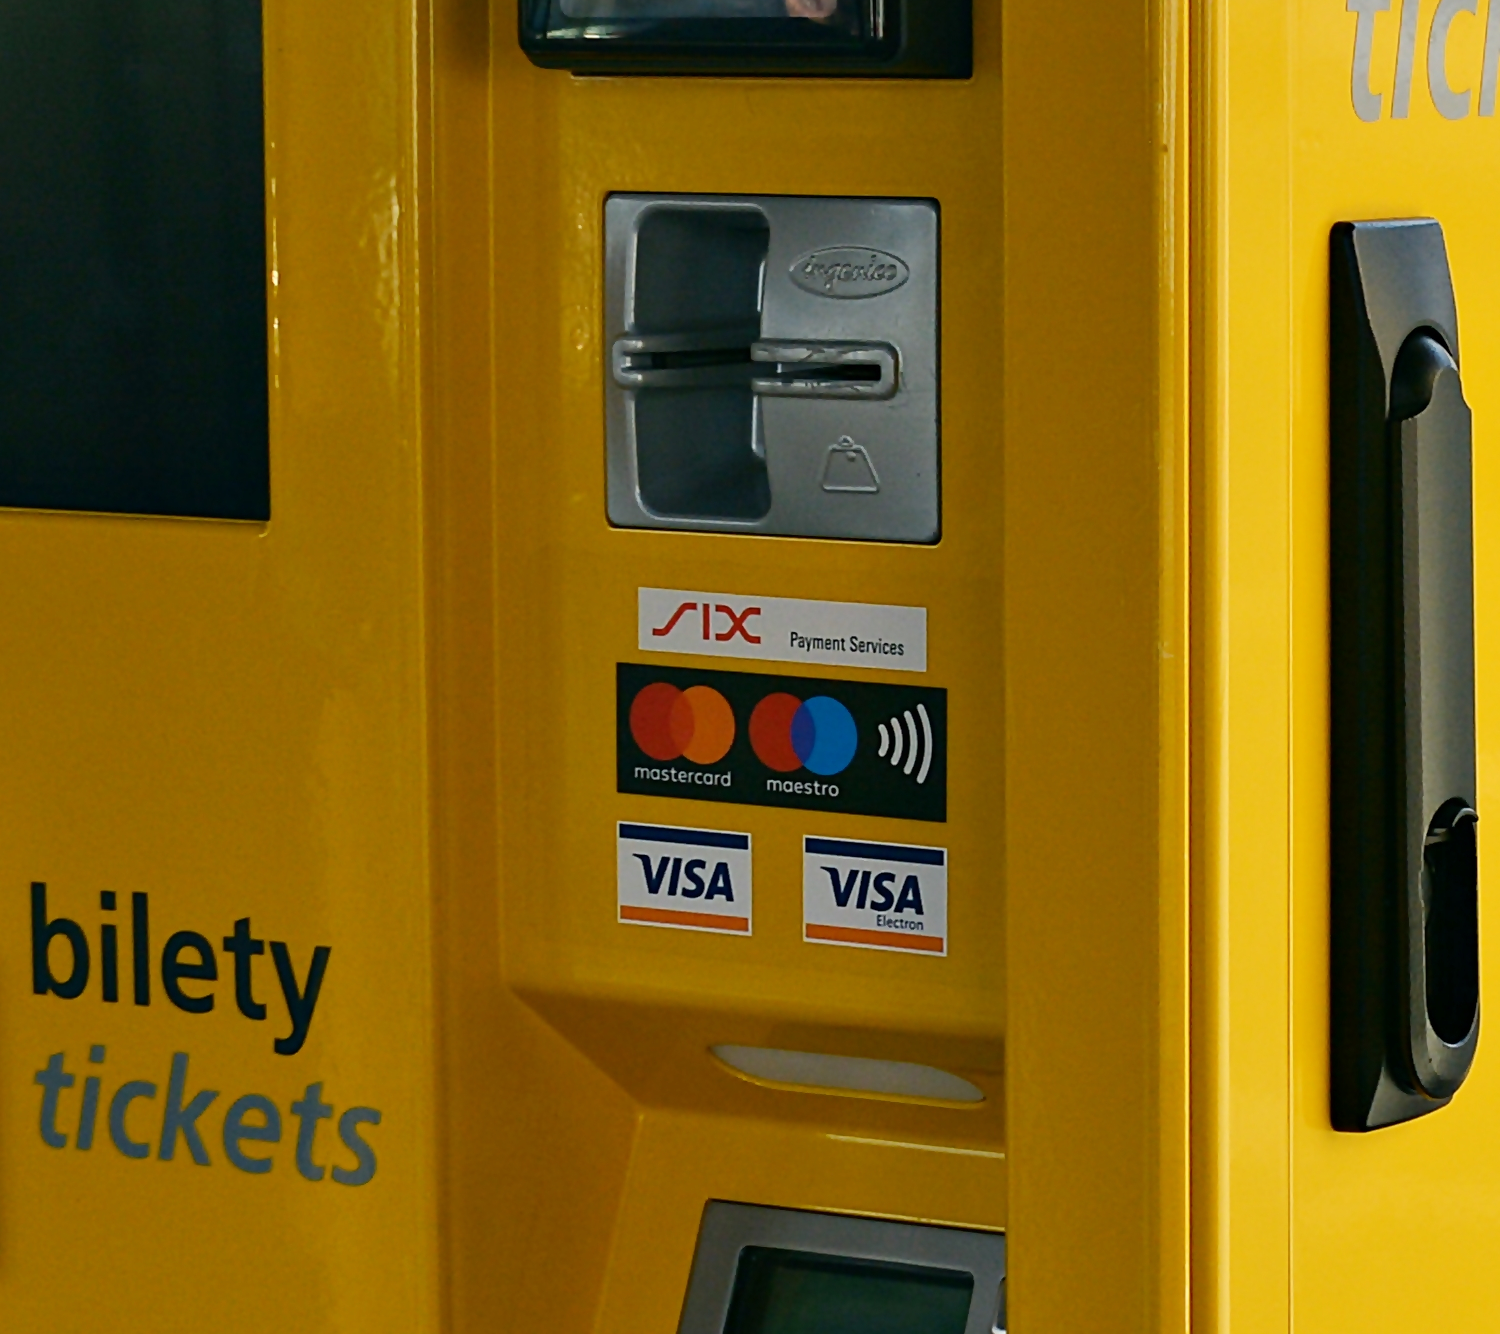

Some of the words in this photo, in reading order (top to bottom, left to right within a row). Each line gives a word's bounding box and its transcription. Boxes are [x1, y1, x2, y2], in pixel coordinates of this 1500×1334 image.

[652, 602, 761, 644] SIX
[790, 632, 845, 653] Payment
[850, 636, 904, 656] Services
[634, 766, 731, 787] mastercard
[766, 778, 839, 797] maestro
[632, 853, 734, 902] VISA
[820, 866, 924, 915] VISA
[876, 914, 924, 931] Electron
[30, 882, 331, 1056] bilety
[34, 1044, 381, 1186] tickets
